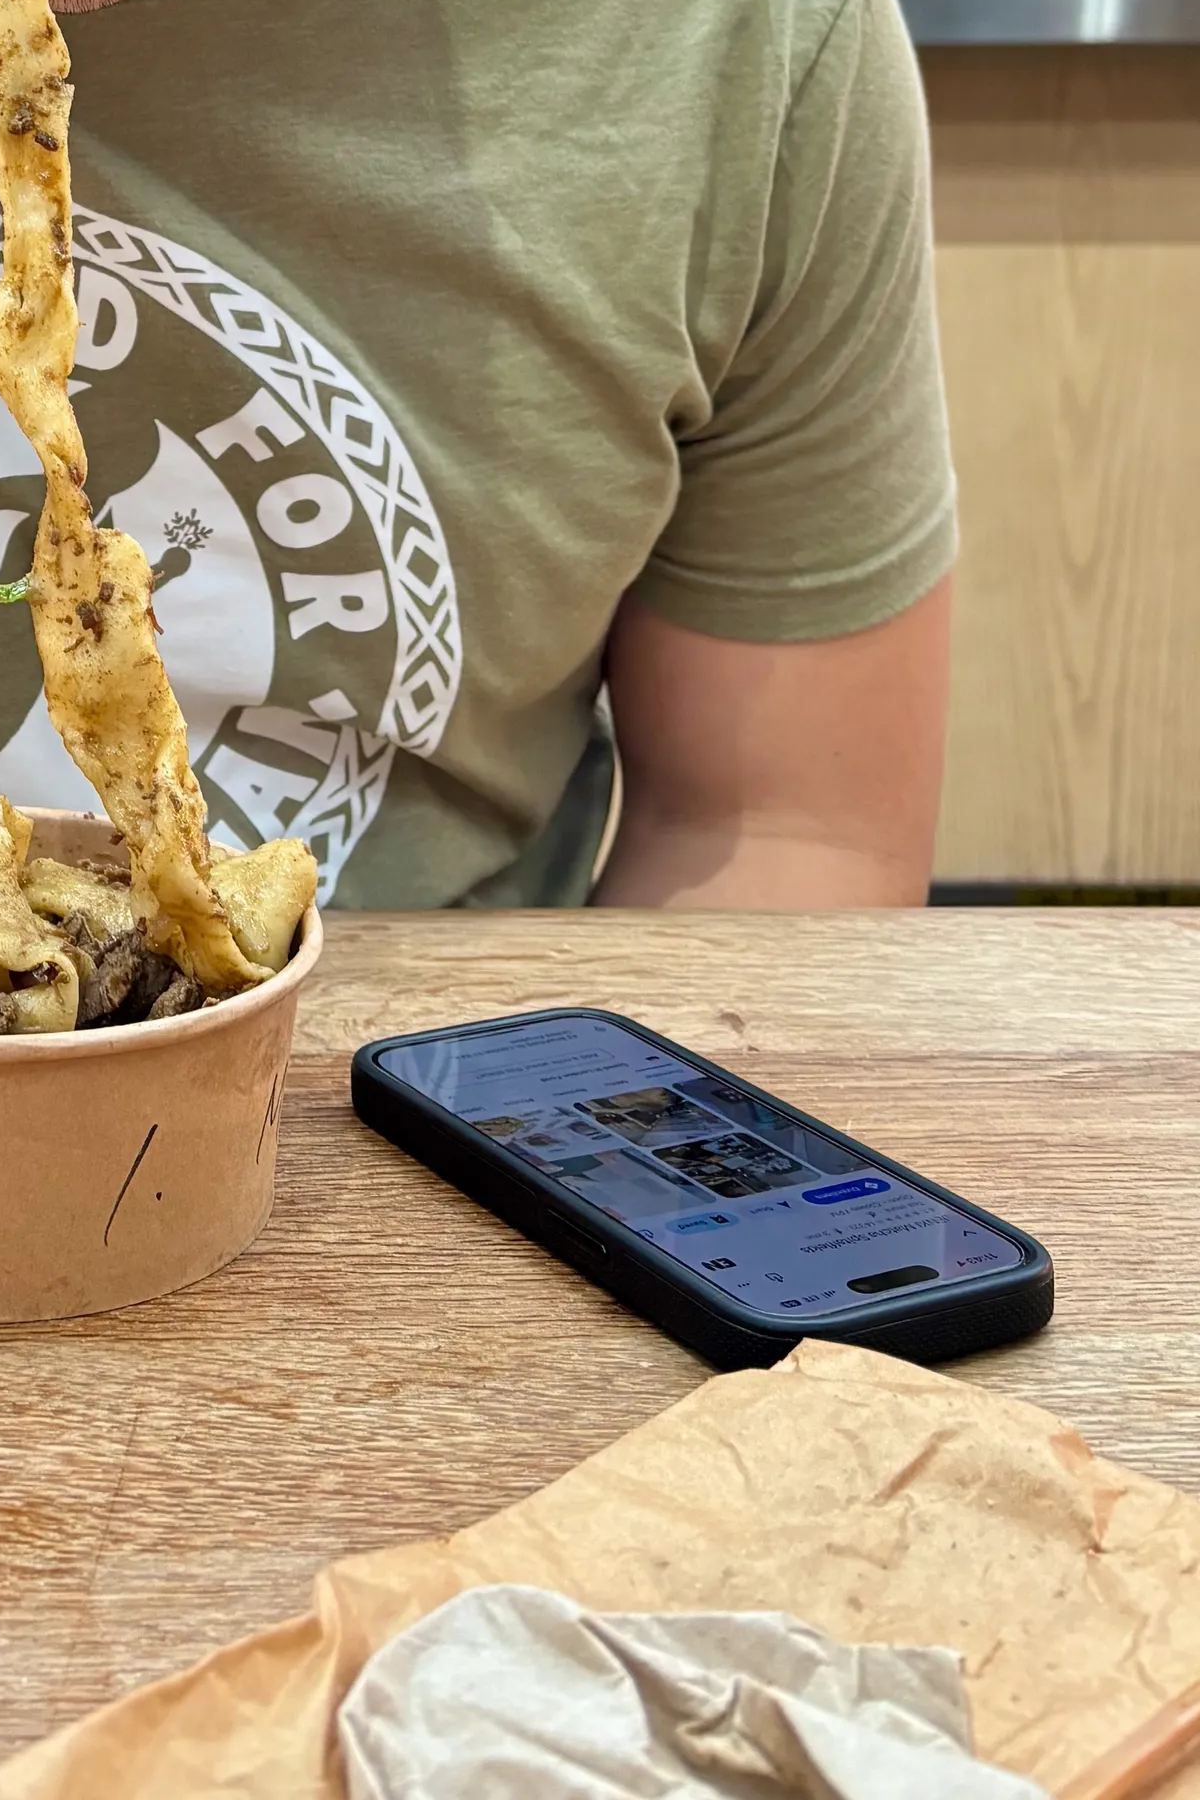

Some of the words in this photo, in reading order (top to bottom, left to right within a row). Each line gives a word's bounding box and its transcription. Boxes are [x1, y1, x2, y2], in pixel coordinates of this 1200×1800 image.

[196, 387, 387, 640] FOR
[867, 1224, 918, 1239] Matcha
[701, 1257, 737, 1271] EN
